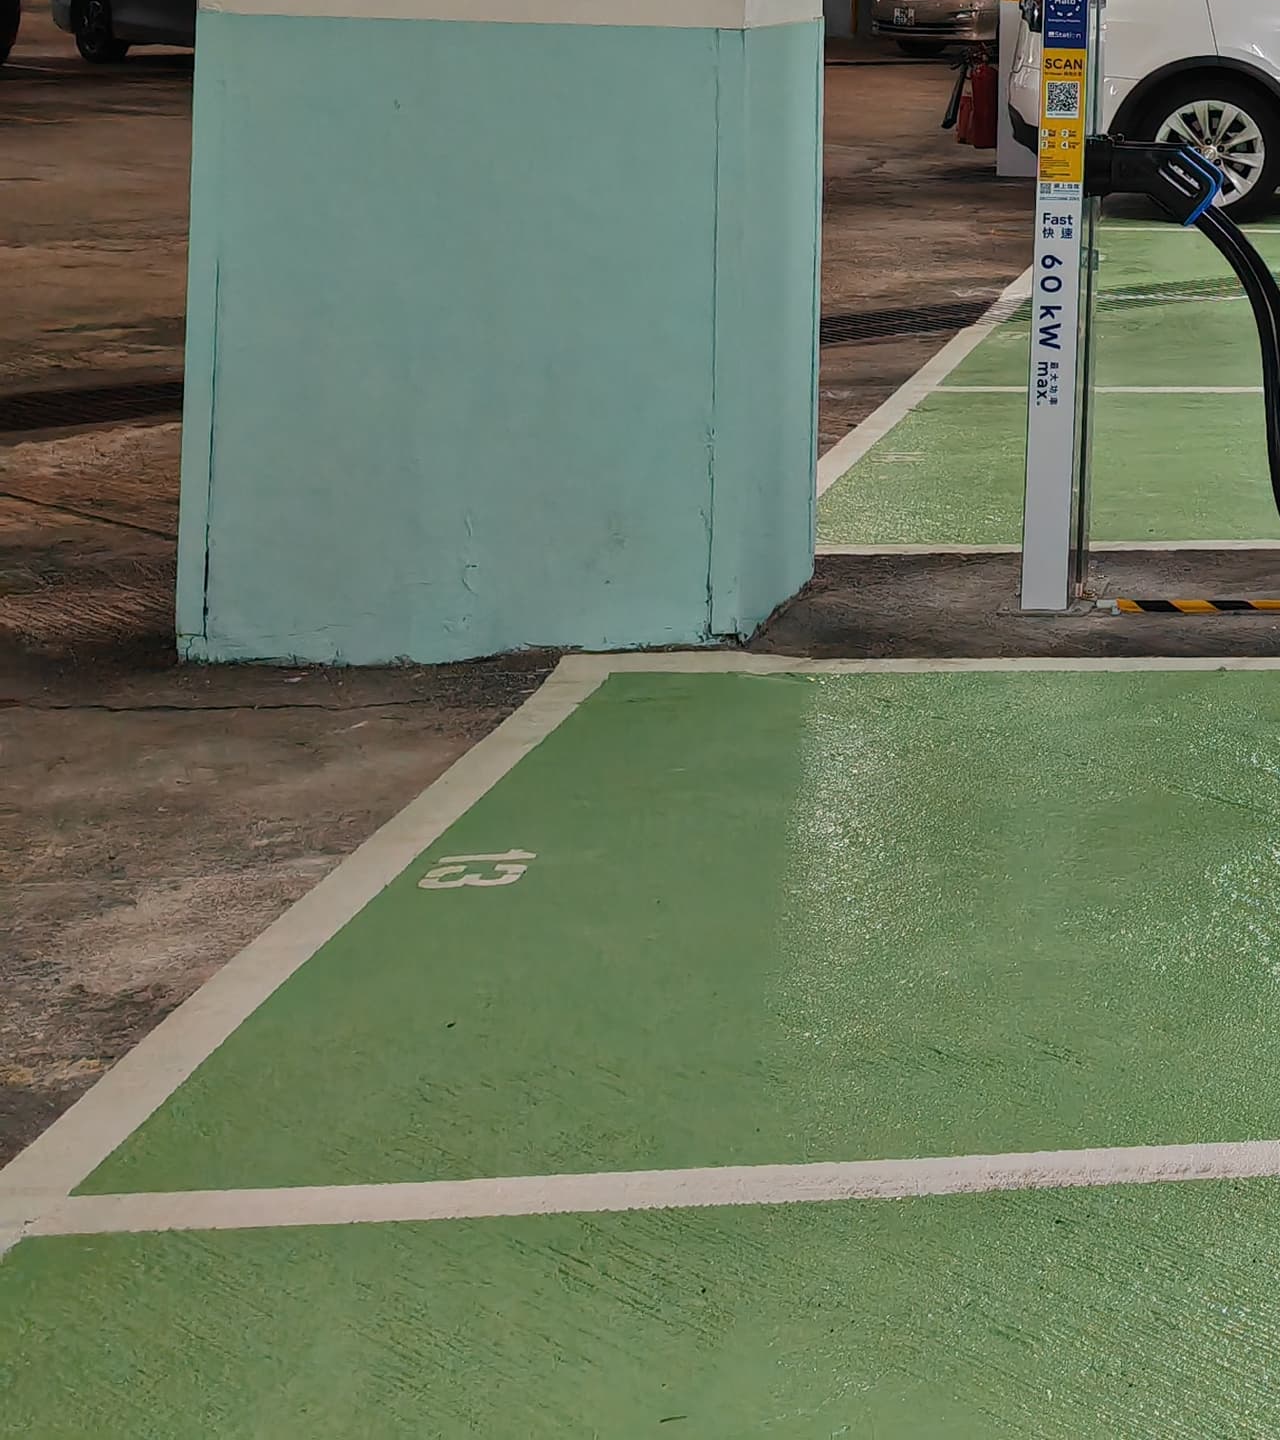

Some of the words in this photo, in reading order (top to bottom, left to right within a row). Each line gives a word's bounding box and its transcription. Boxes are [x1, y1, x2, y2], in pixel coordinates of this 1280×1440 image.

[1044, 58, 1083, 70] SCAN
[1042, 212, 1073, 226] Fast
[1042, 226, 1073, 239] 快速
[1040, 254, 1063, 293] 60
[1038, 305, 1063, 350] kW
[1049, 361, 1059, 406] 最大功率
[418, 848, 537, 890] 13
